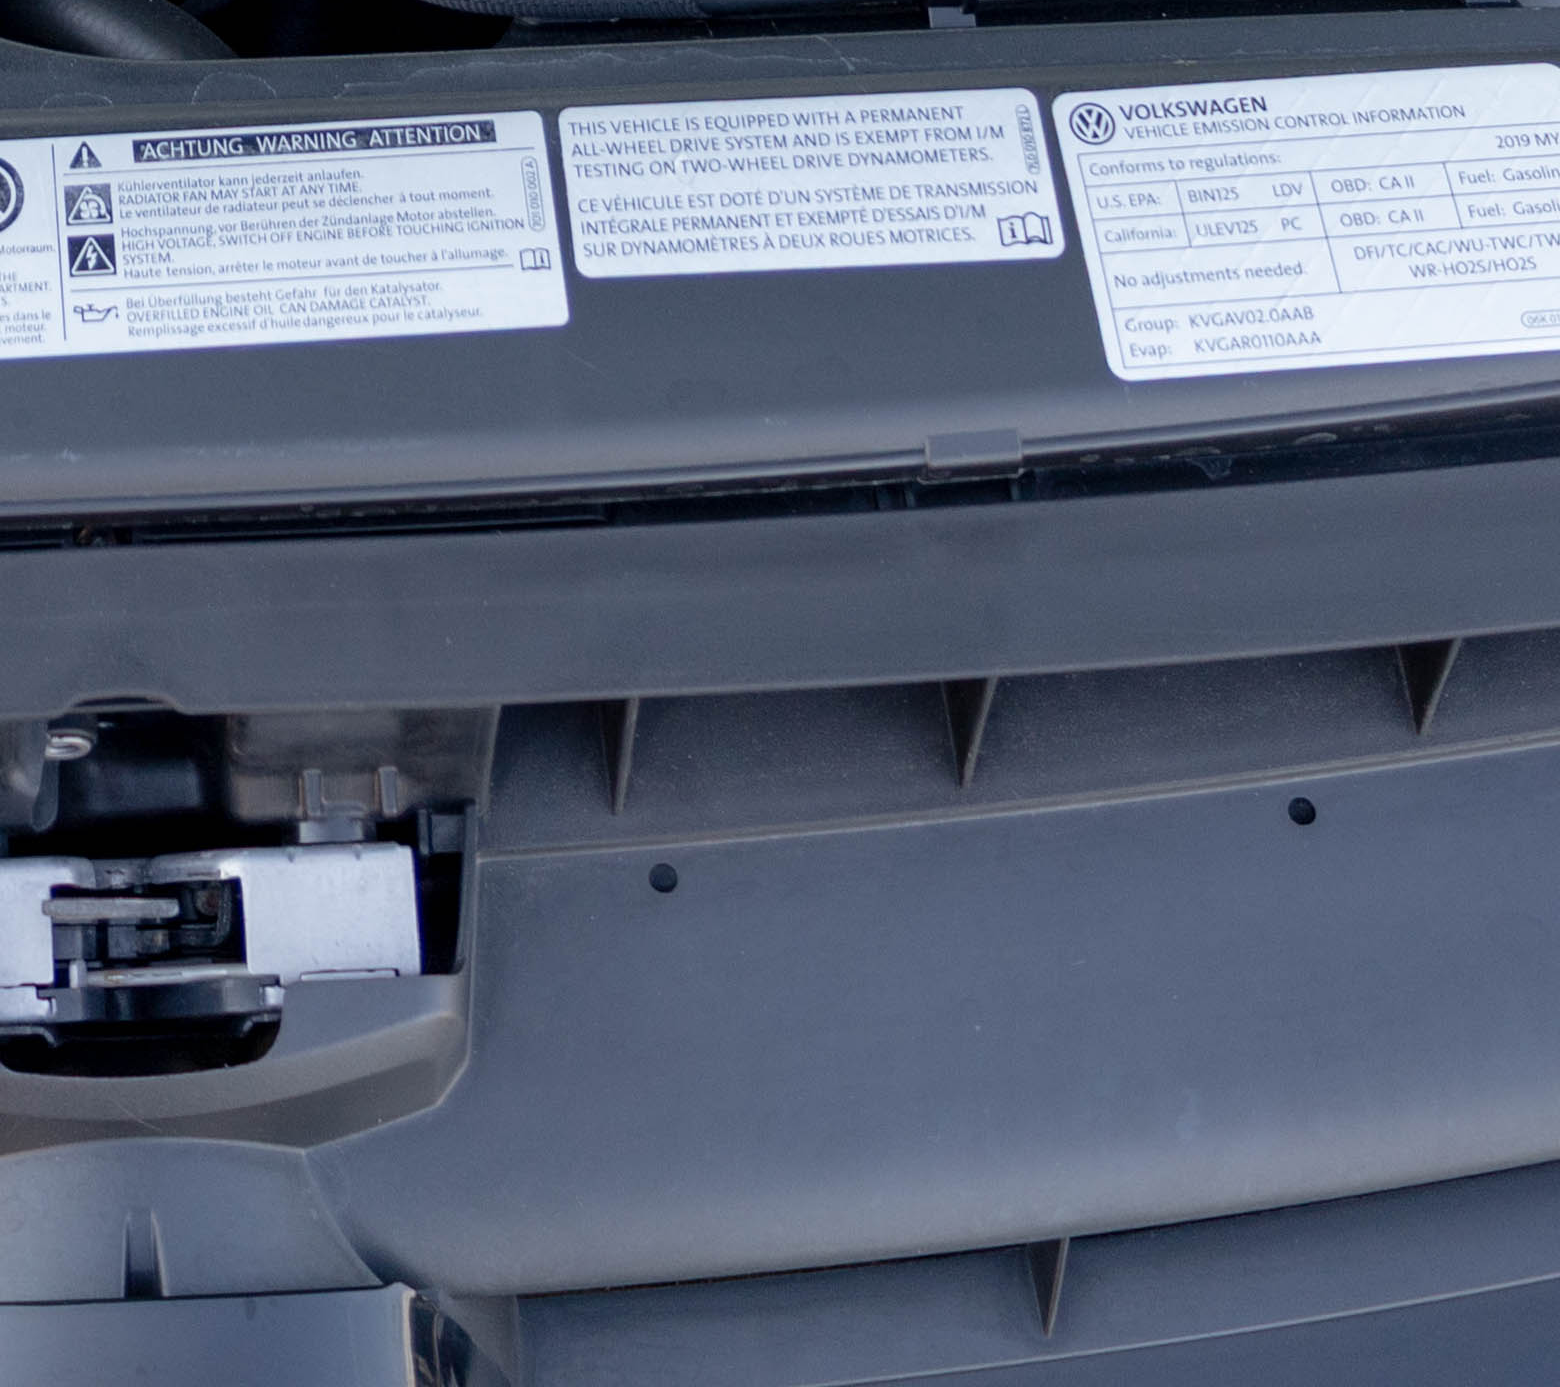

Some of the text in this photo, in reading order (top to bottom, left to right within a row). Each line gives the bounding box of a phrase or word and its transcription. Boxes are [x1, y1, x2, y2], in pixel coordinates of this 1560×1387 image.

[569, 106, 964, 136] THIS VEHICLE IS EQUIPPED WITH A PERMANENT
[1119, 96, 1268, 120] VOLKSWAGEN
[1125, 105, 1466, 139] VEHICLE EMISSION CONTROL INFORMATION
[142, 124, 480, 160] ACHTUNG WARNING ATTENTION
[572, 125, 1005, 157] ALL-WHEEL DRIVE SYSTEM AND IS EXEMPT FROM I/M
[1496, 132, 1560, 149] 2019 MY
[574, 147, 993, 178] TESTING ON TWO-WHEEL DRIVE DYNAMOMETERS.
[1089, 152, 1281, 176] Conforms to regulations:
[578, 180, 1038, 214] CE VÉHICULE EST DOTÉ D'UN SYSTÈME DE TRANSMISSION
[1097, 194, 1126, 209] U.S.
[1130, 192, 1161, 207] EPA:
[1187, 186, 1240, 203] BIN125
[1272, 183, 1303, 198] LDV
[1331, 179, 1371, 194] OBD:
[1380, 176, 1402, 190] CA
[1406, 175, 1414, 189] II
[1458, 169, 1495, 185] Fuel:
[122, 218, 525, 251] HIGH VOLTAGE, SWITCH OFF ENGINE BEFORE TOUCHING IGNITION
[1105, 226, 1176, 244] California:
[1195, 219, 1258, 237] ULEV125
[1281, 217, 1303, 232] PC
[1340, 212, 1380, 228] OBD:
[1388, 209, 1410, 224] CA
[1414, 208, 1424, 223] II
[1468, 203, 1506, 219] Fuel:
[1114, 274, 1137, 288] No
[1142, 266, 1240, 290] adjustments
[1125, 305, 1314, 334] Group: KVGAV02.0AAB
[1130, 343, 1172, 359] Evap:
